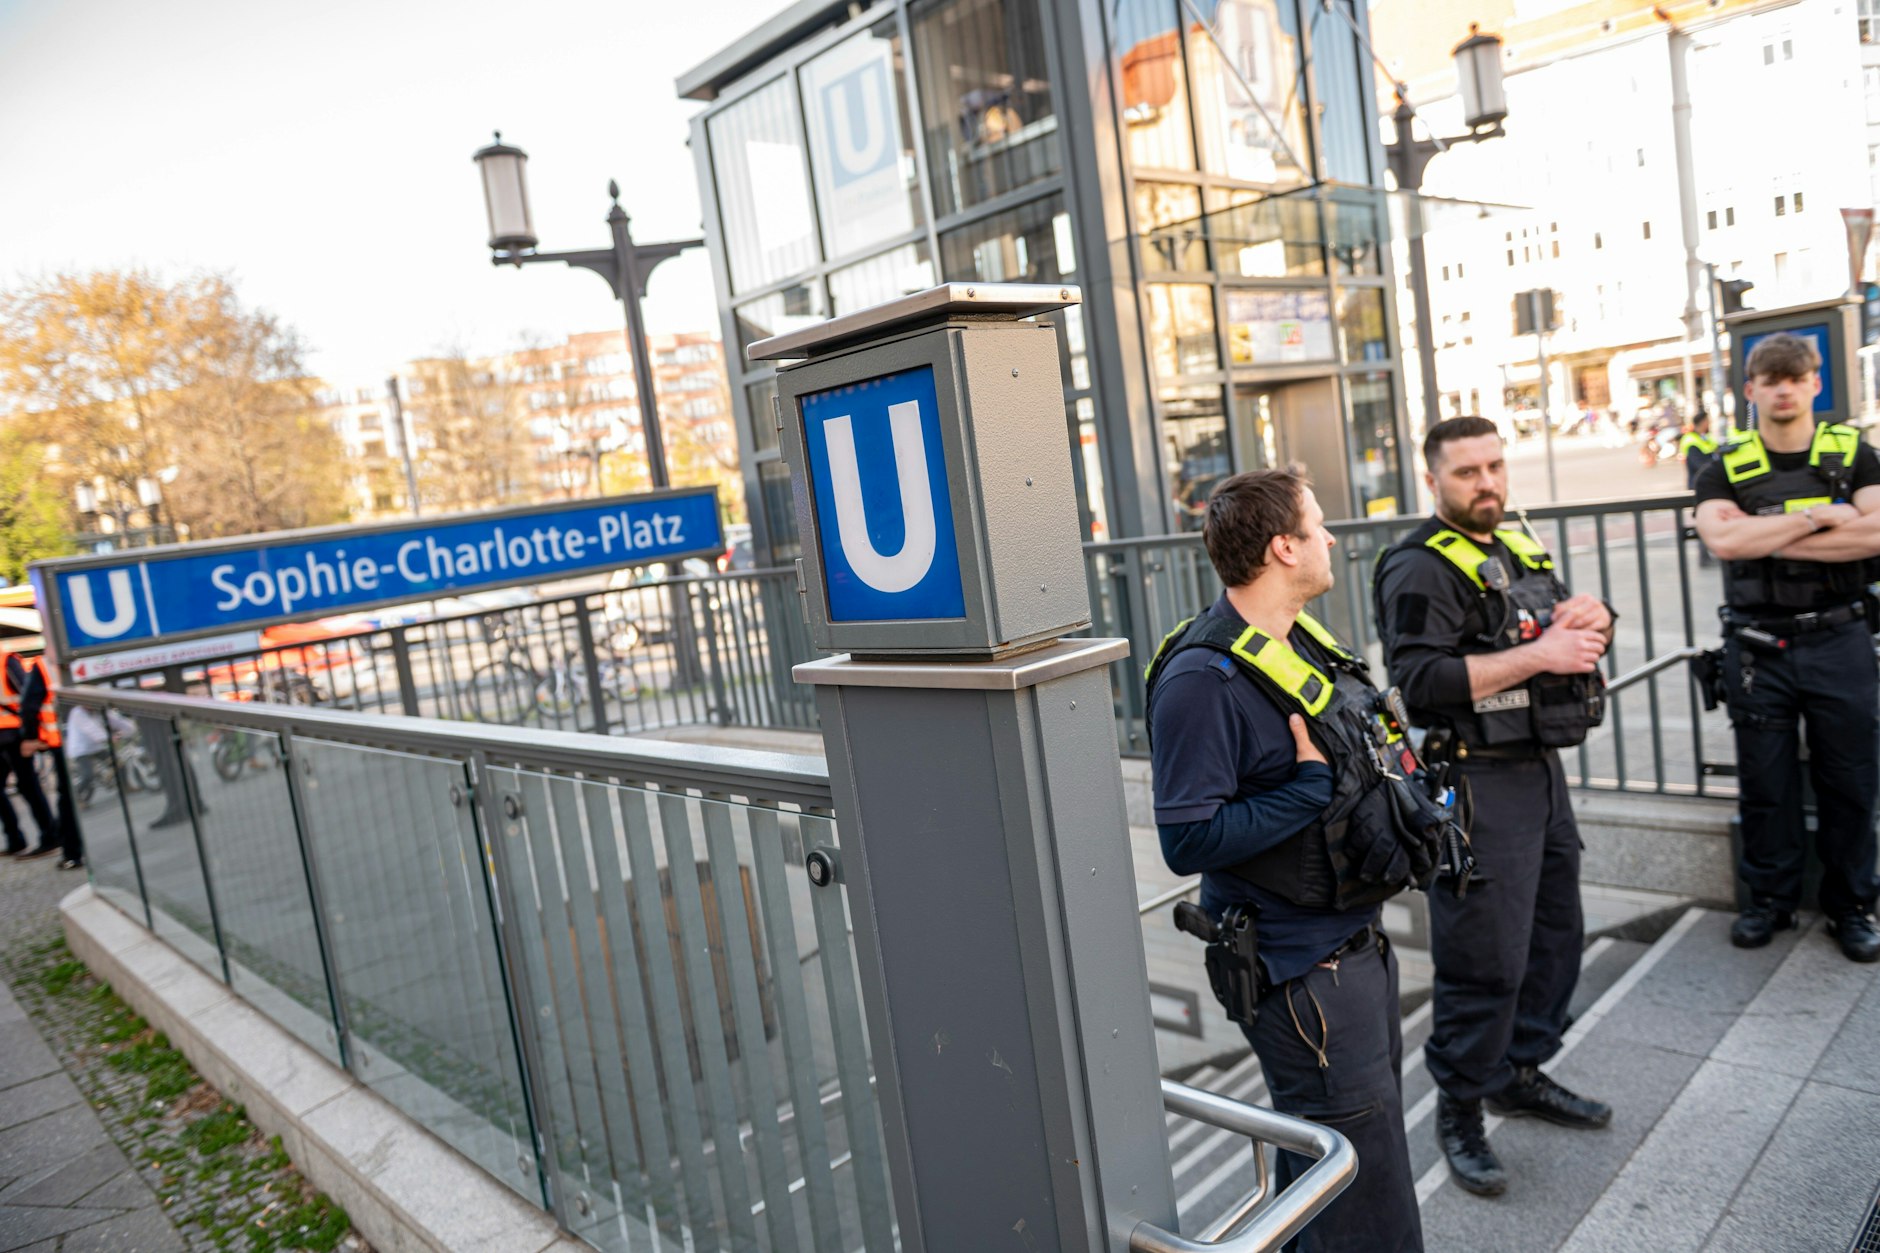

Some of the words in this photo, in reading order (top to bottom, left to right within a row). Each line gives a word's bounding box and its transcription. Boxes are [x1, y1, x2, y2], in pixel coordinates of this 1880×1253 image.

[829, 66, 886, 174] U
[823, 399, 936, 593] U
[67, 569, 137, 639] U
[211, 510, 685, 615] Sophie-Charlotte-Platz
